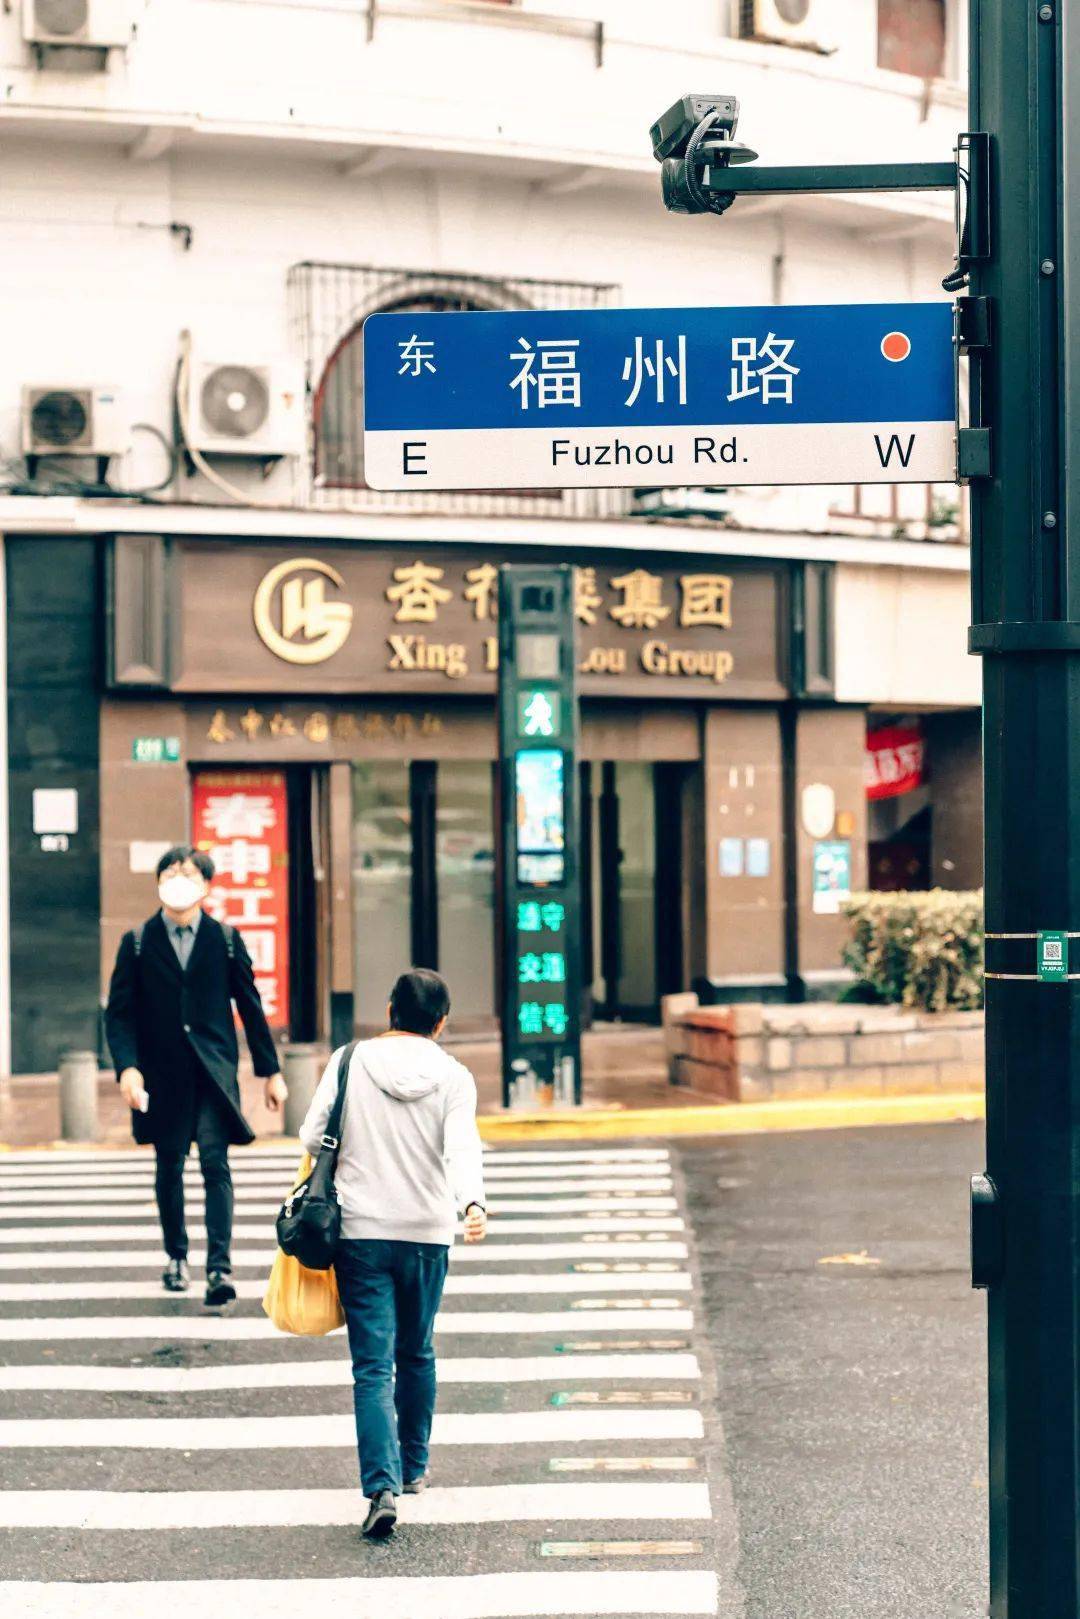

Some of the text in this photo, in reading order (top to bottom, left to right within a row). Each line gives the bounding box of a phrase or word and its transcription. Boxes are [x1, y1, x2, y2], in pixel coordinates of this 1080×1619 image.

[398, 334, 437, 377] 东
[509, 331, 801, 410] 福州路
[403, 442, 428, 475] E
[552, 436, 749, 466] Fuzhou Rd.
[874, 433, 916, 468] W
[389, 635, 468, 679] Xing
[641, 639, 734, 684] Group
